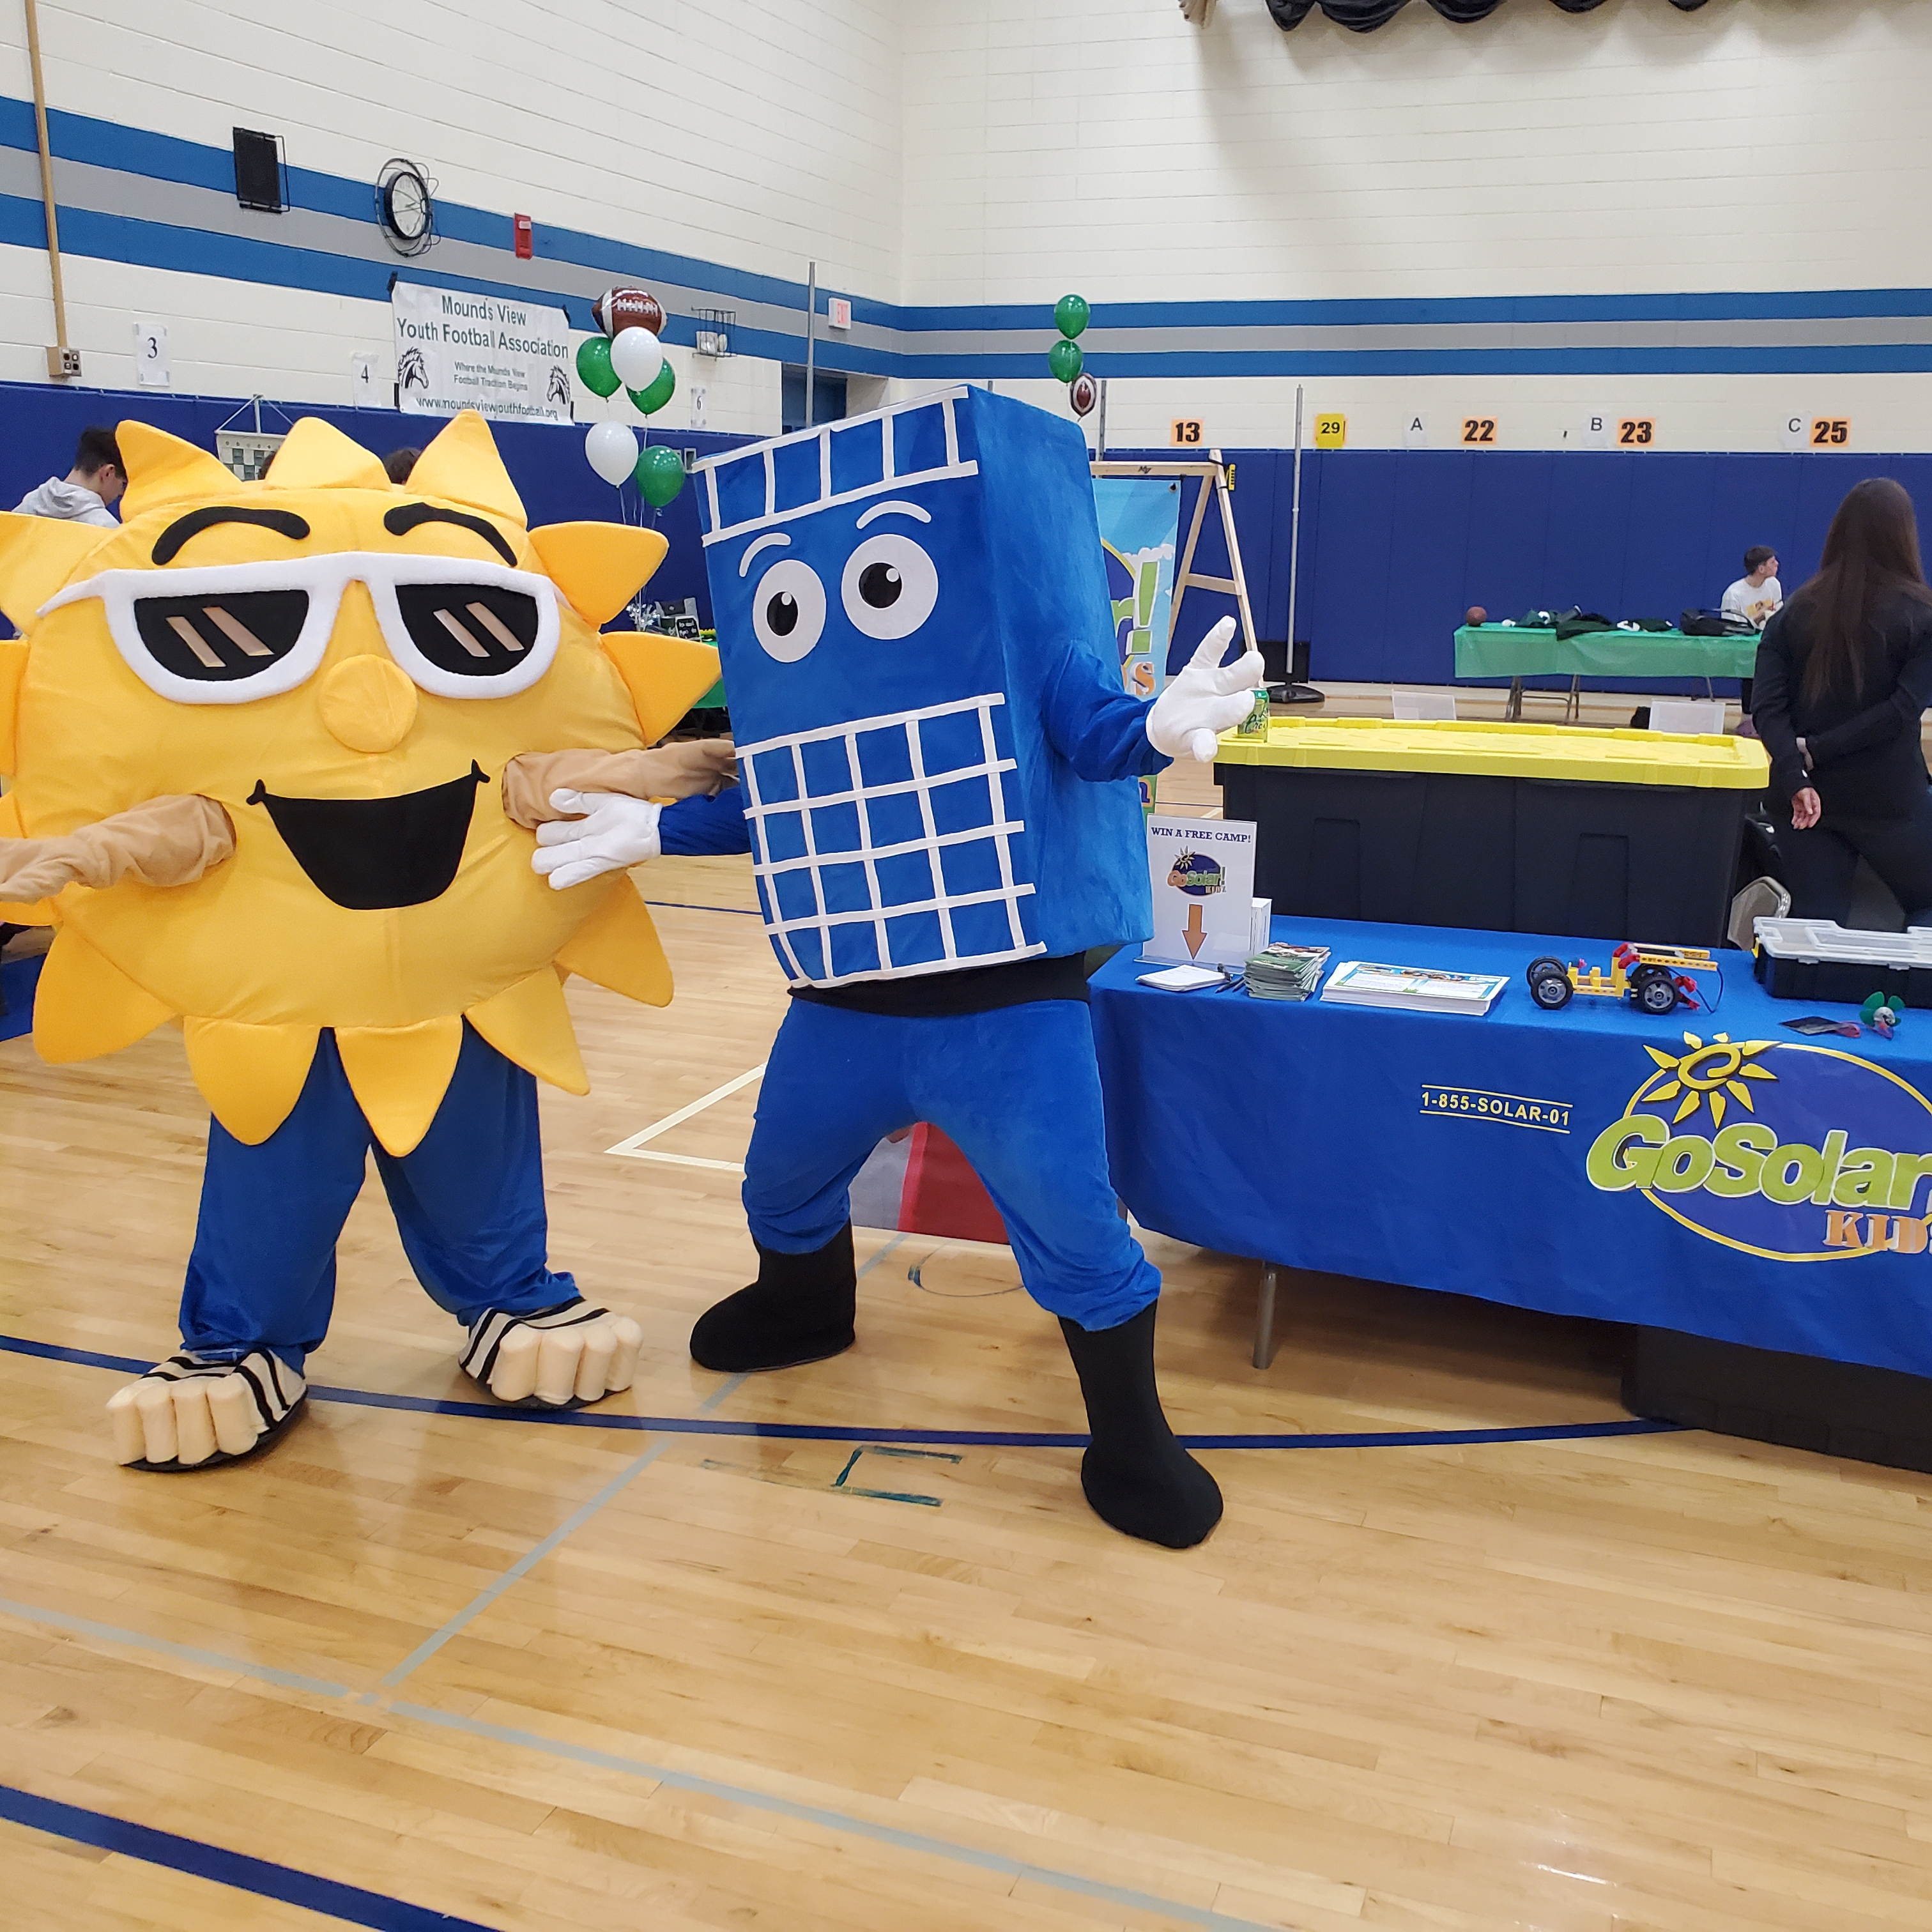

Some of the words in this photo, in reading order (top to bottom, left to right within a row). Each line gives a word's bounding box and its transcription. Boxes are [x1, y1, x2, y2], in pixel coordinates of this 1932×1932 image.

[441, 295, 493, 321] Mounds
[497, 304, 526, 326] View
[147, 337, 158, 358] 3
[397, 318, 438, 342] Youth
[443, 324, 495, 348] Football
[498, 332, 569, 358] Association
[361, 364, 369, 383] 4
[696, 395, 702, 410] 6
[1176, 422, 1200, 442] 13
[1321, 422, 1340, 434] 29
[1410, 417, 1423, 431] A
[1464, 420, 1494, 441] 22
[1591, 417, 1602, 431] B
[1621, 422, 1652, 443] 23
[1788, 418, 1801, 433] C
[1814, 421, 1847, 443] 25
[1151, 827, 1173, 836] WIN
[1175, 829, 1183, 838] A
[1185, 830, 1213, 839] FREE
[1215, 832, 1251, 843] CAMP!
[1167, 866, 1226, 886] GoSolar!
[1422, 1091, 1570, 1126] 1-855-SOLAR-01
[1586, 1114, 1932, 1210] GoSolar
[1823, 1209, 1932, 1254] KID
